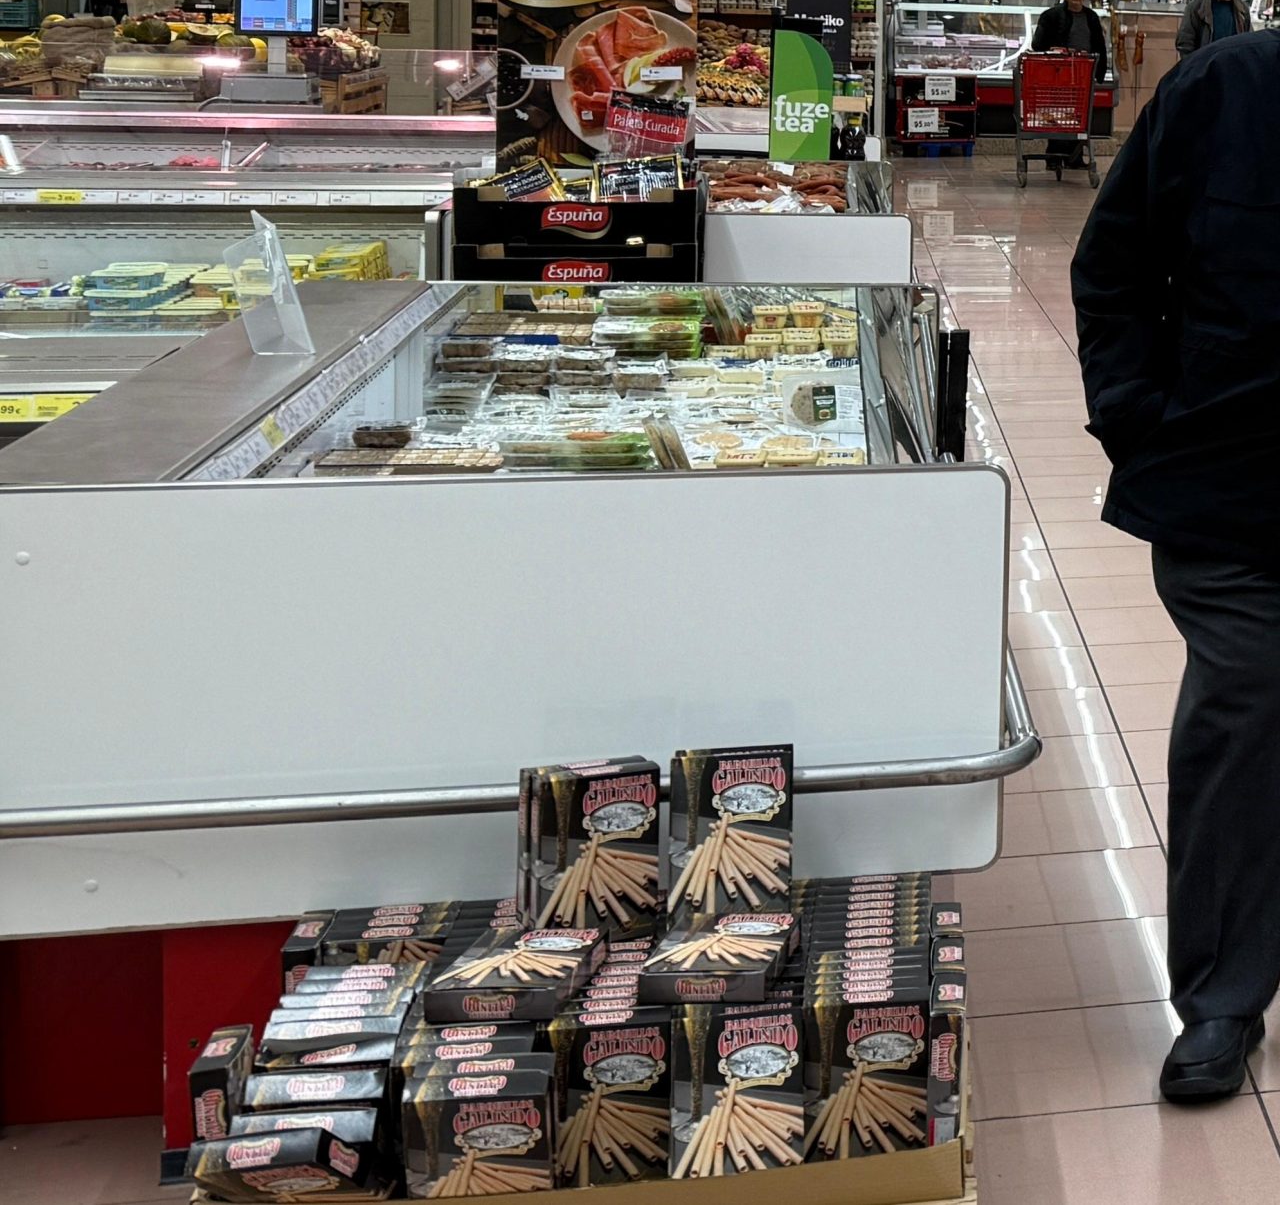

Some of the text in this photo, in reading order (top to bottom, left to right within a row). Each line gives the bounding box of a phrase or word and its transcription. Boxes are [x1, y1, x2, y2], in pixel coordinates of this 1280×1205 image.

[774, 94, 830, 118] fuze
[613, 112, 680, 136] Paleta Curada
[774, 115, 815, 134] tea
[547, 206, 603, 223] Espuña
[547, 264, 603, 281] Espuña
[719, 757, 781, 771] BARQUILLOS
[712, 766, 786, 794] GALINDO
[583, 783, 657, 815] GALINDO
[724, 1014, 793, 1031] BARQUILLOS
[854, 1005, 920, 1018] BARQUILLOS
[590, 1026, 660, 1042] BARQUILLOS
[847, 1014, 925, 1043] GALINDO
[583, 1036, 666, 1066] GALINDO
[718, 1025, 799, 1057] GALINDO
[453, 1107, 541, 1135] GALINDO
